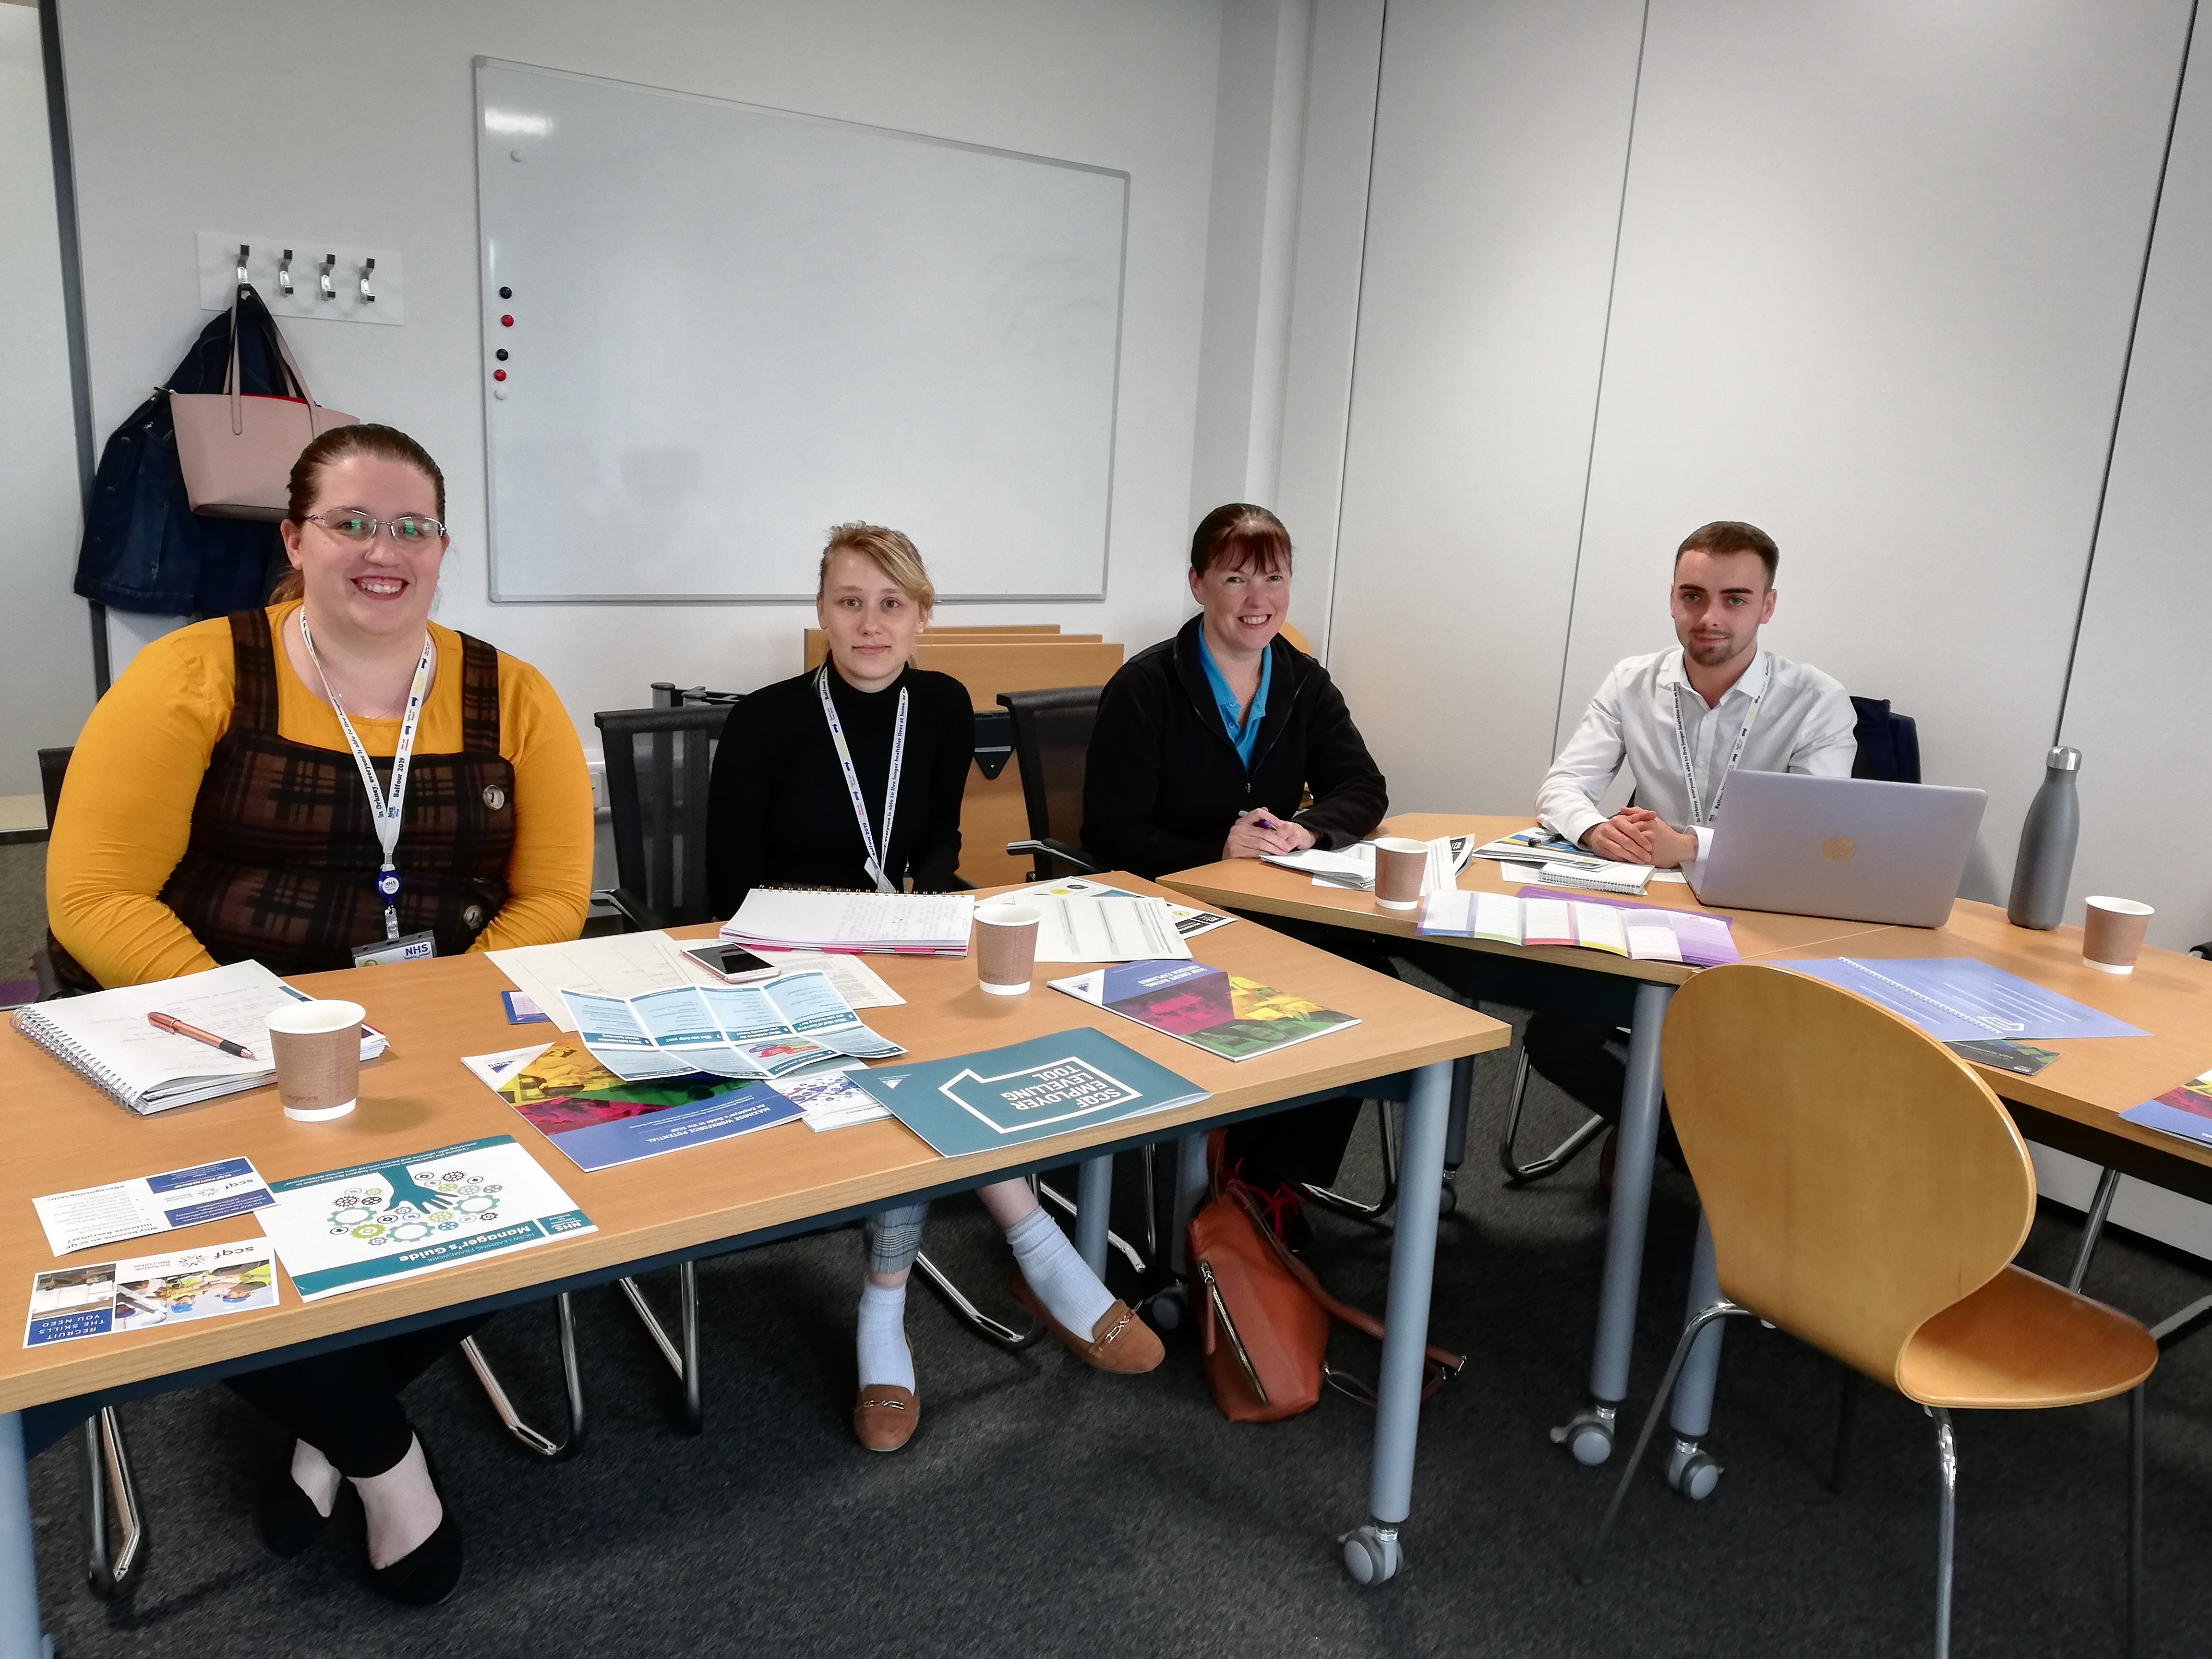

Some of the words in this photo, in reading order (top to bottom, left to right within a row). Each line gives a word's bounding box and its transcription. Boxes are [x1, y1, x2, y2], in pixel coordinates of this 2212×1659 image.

[360, 754, 375, 783] everyone
[393, 773, 402, 798] Balfour
[370, 783, 383, 810] Orkney,
[866, 836, 875, 856] Balfour
[405, 944, 428, 956] NHS
[1169, 964, 1200, 974] CRITERIA
[1135, 972, 1175, 985] EXPLAINED
[796, 1022, 818, 1031] learning
[1031, 1065, 1082, 1082] TOOL
[998, 1072, 1095, 1101] LEVELLING
[1008, 1080, 1109, 1111] EMPLOYER
[1073, 1088, 1123, 1108] SCQF
[723, 1106, 757, 1118] Employer's
[732, 1106, 772, 1121] MAXIMISE
[687, 1118, 734, 1133] WORKFORCE
[644, 1130, 689, 1143] POTENTIAL
[222, 1178, 255, 1190] scqf
[113, 1222, 152, 1234] Inclusive
[553, 1221, 582, 1232] NHS
[66, 1231, 112, 1243] Recruiter?
[103, 1230, 138, 1240] become
[447, 1225, 531, 1251] Manager's
[512, 1232, 535, 1241] HCSW
[65, 1240, 89, 1249] SCQF
[474, 1238, 512, 1251] LEARNING
[213, 1245, 254, 1259] scqf
[398, 1246, 447, 1263] Guide
[426, 1247, 475, 1262] FRAMEWORK
[133, 1259, 170, 1269] Recruiter
[134, 1262, 170, 1272] Inclusive
[41, 1318, 72, 1328] NEED
[77, 1313, 100, 1322] YOU
[83, 1319, 104, 1327] THE
[37, 1323, 78, 1334] SKILLS
[46, 1326, 96, 1340] RECRUIT
